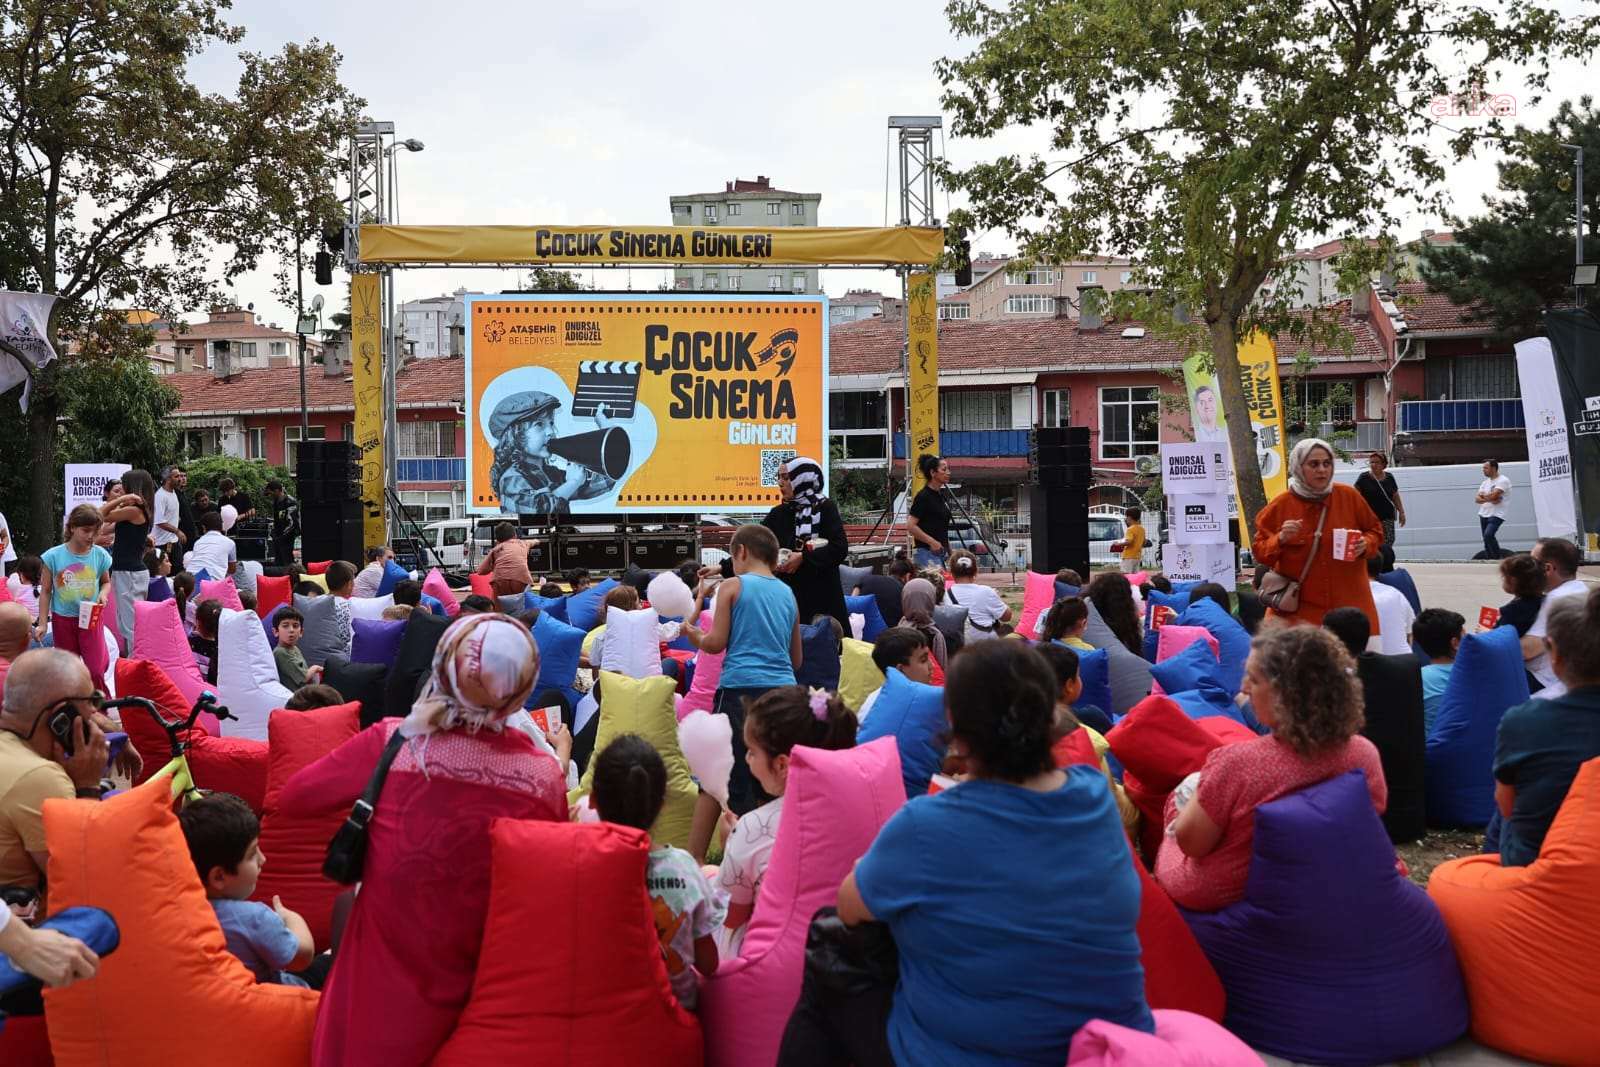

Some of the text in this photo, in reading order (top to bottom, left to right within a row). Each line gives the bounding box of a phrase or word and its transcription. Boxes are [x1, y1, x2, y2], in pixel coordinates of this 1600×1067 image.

[565, 321, 601, 331] ONURSAL
[645, 324, 758, 376] ÇOCUK
[1169, 455, 1205, 466] ONURSAL
